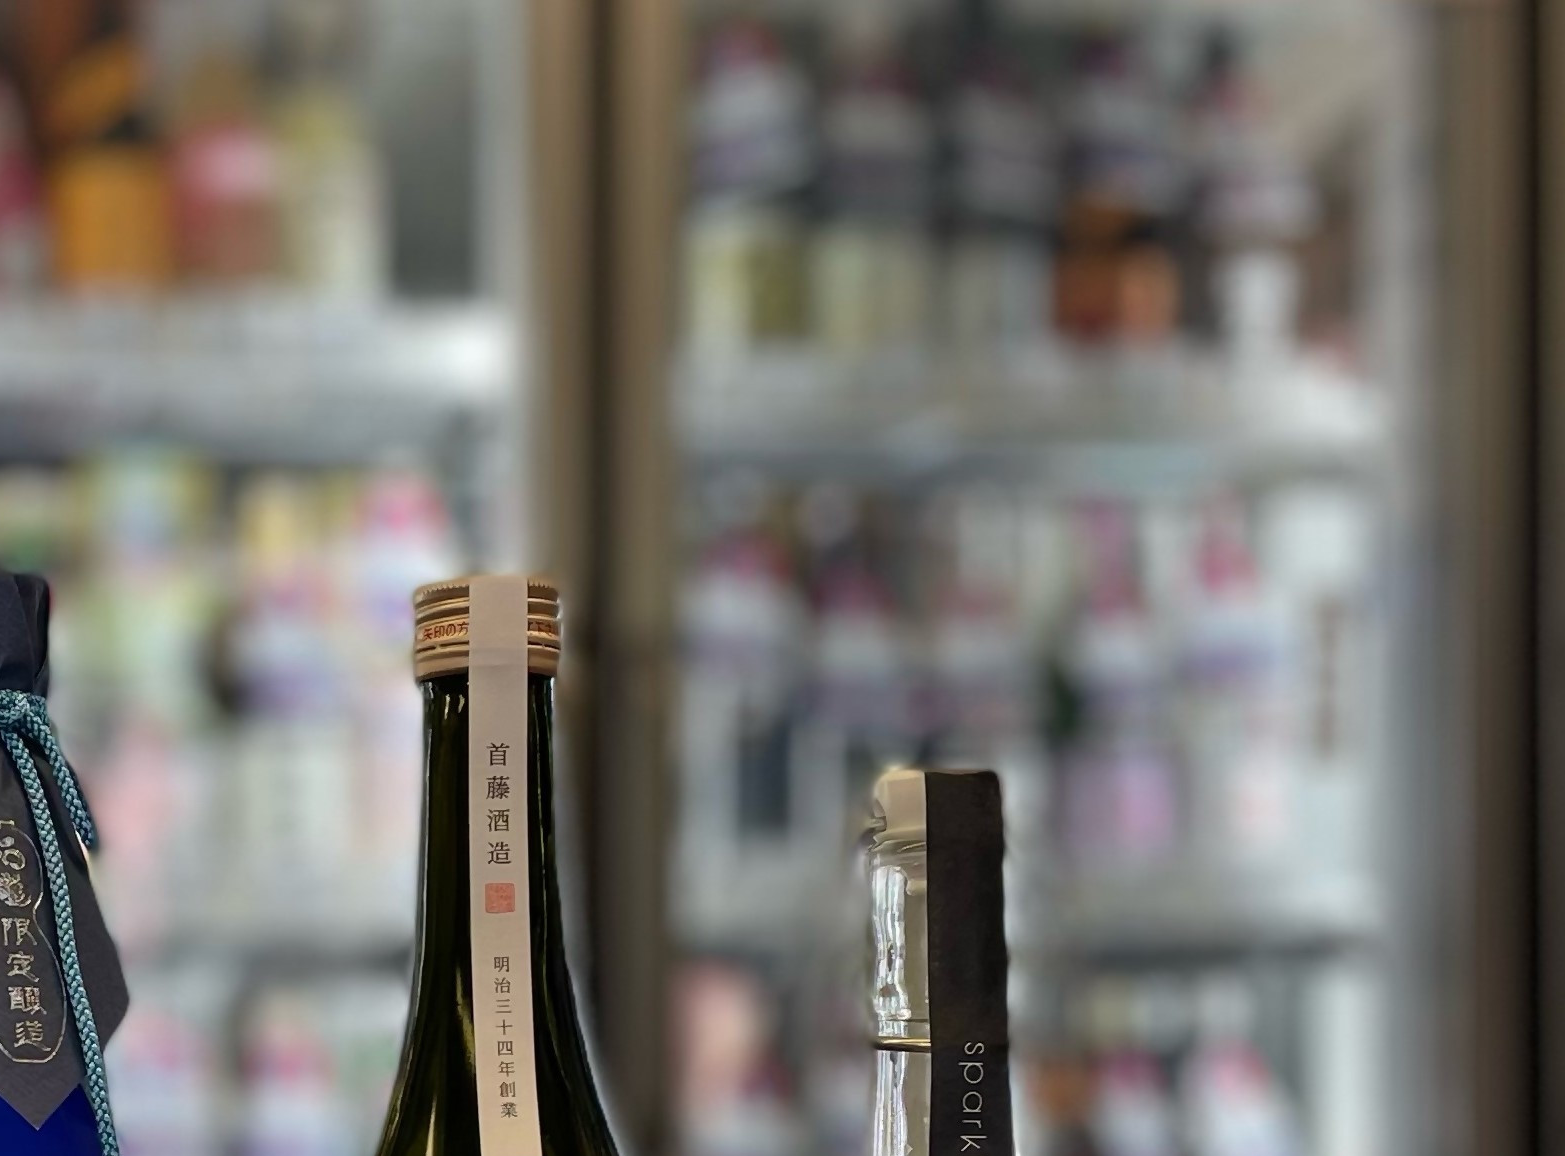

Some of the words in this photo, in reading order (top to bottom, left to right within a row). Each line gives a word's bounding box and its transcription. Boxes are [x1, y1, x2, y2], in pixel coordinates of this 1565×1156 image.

[485, 741, 512, 866] 首藤酒造
[493, 954, 519, 1119] 明治三十四年創業
